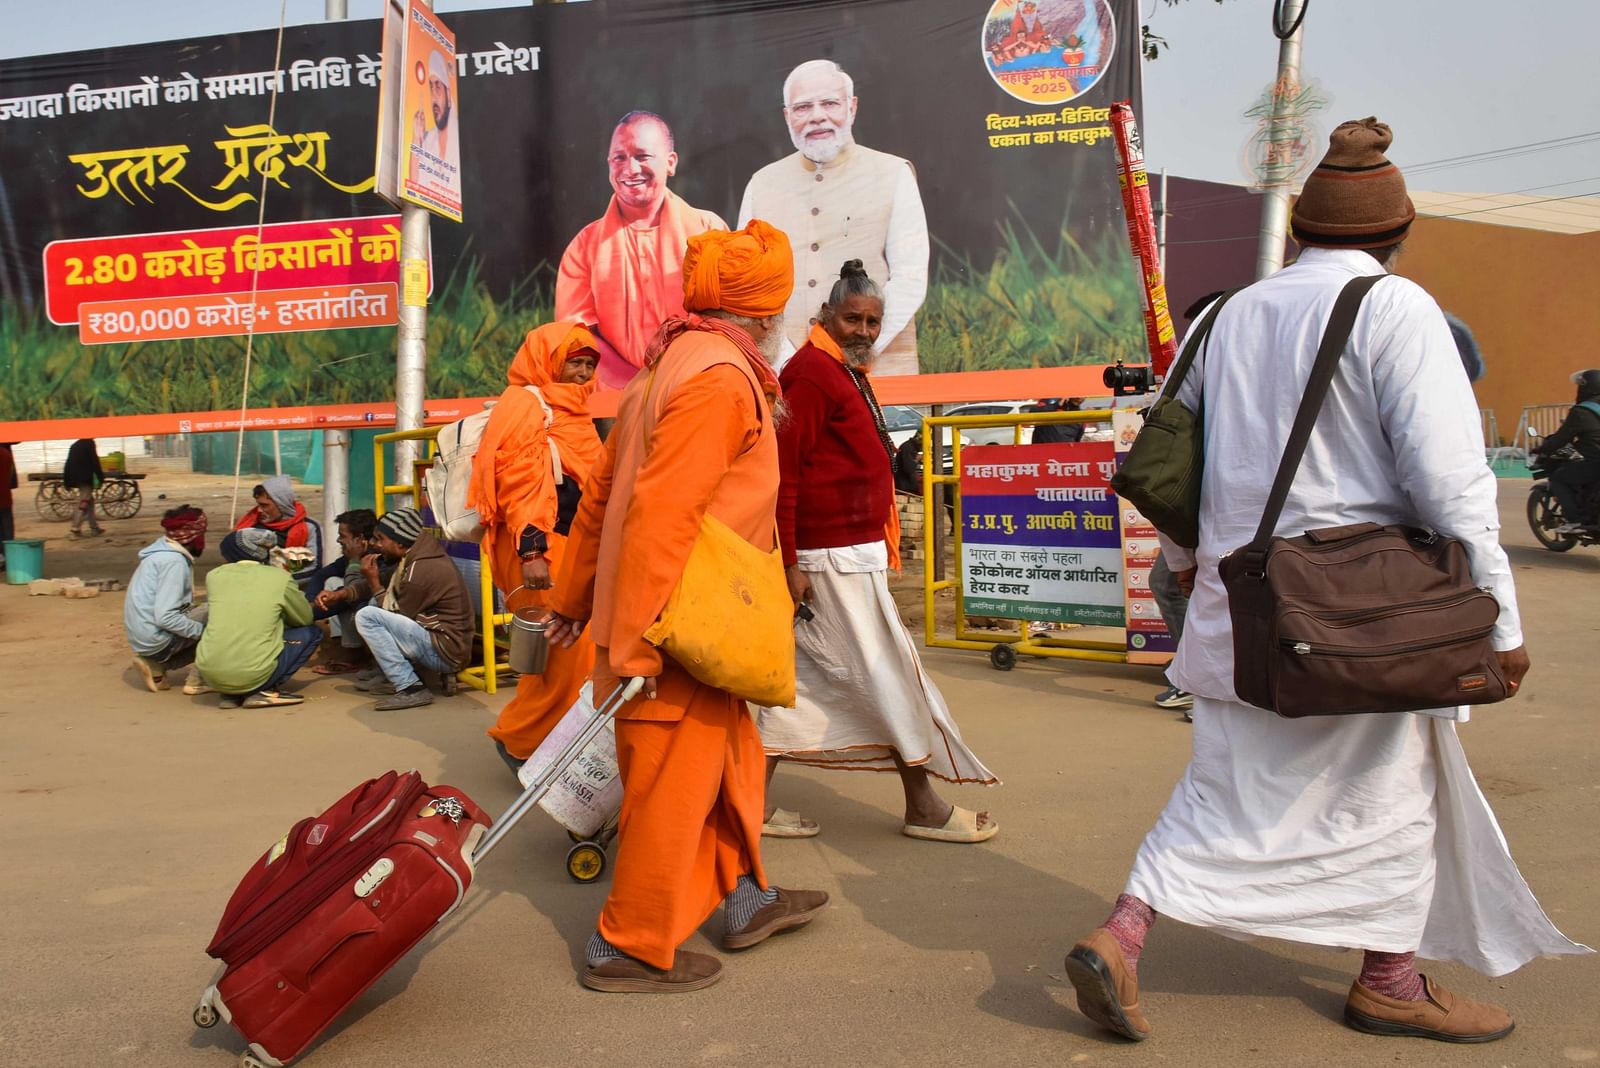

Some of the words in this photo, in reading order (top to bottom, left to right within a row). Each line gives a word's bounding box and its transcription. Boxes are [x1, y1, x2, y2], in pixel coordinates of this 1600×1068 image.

[472, 42, 541, 75] प्रदेश
[0, 93, 63, 120] ज्यादा
[66, 83, 160, 114] किसानों
[161, 72, 199, 103] को
[203, 70, 285, 99] सम्मान
[289, 57, 351, 92] निधि
[1031, 82, 1066, 94] 2025
[988, 133, 1031, 147] एकता
[1032, 131, 1055, 144] का
[68, 145, 257, 211] उत्तर
[211, 124, 376, 193] प्रदेश
[65, 253, 137, 286] 2.80
[142, 239, 227, 284] करोड़
[232, 234, 353, 273] किसानों
[358, 224, 401, 264] को
[89, 307, 191, 335] ₹80,000
[275, 288, 388, 325] हस्तांतरित
[964, 463, 1040, 482] महाकुम्भ
[1045, 459, 1090, 476] मेला
[1034, 487, 1107, 501] यातायात
[968, 514, 1018, 535] उ.प्र.पु.
[1026, 510, 1077, 530] आपकी
[1081, 510, 1114, 530] सेवा
[969, 548, 996, 561] भारत
[1001, 550, 1015, 562] का
[1020, 548, 1048, 564] सबसे
[1053, 551, 1082, 566] पहला
[969, 562, 1023, 579] कोकोनट
[1026, 564, 1061, 581] ऑयल
[1063, 566, 1118, 584] आधारित
[969, 577, 995, 593] हेयर
[998, 582, 1029, 595] कलर
